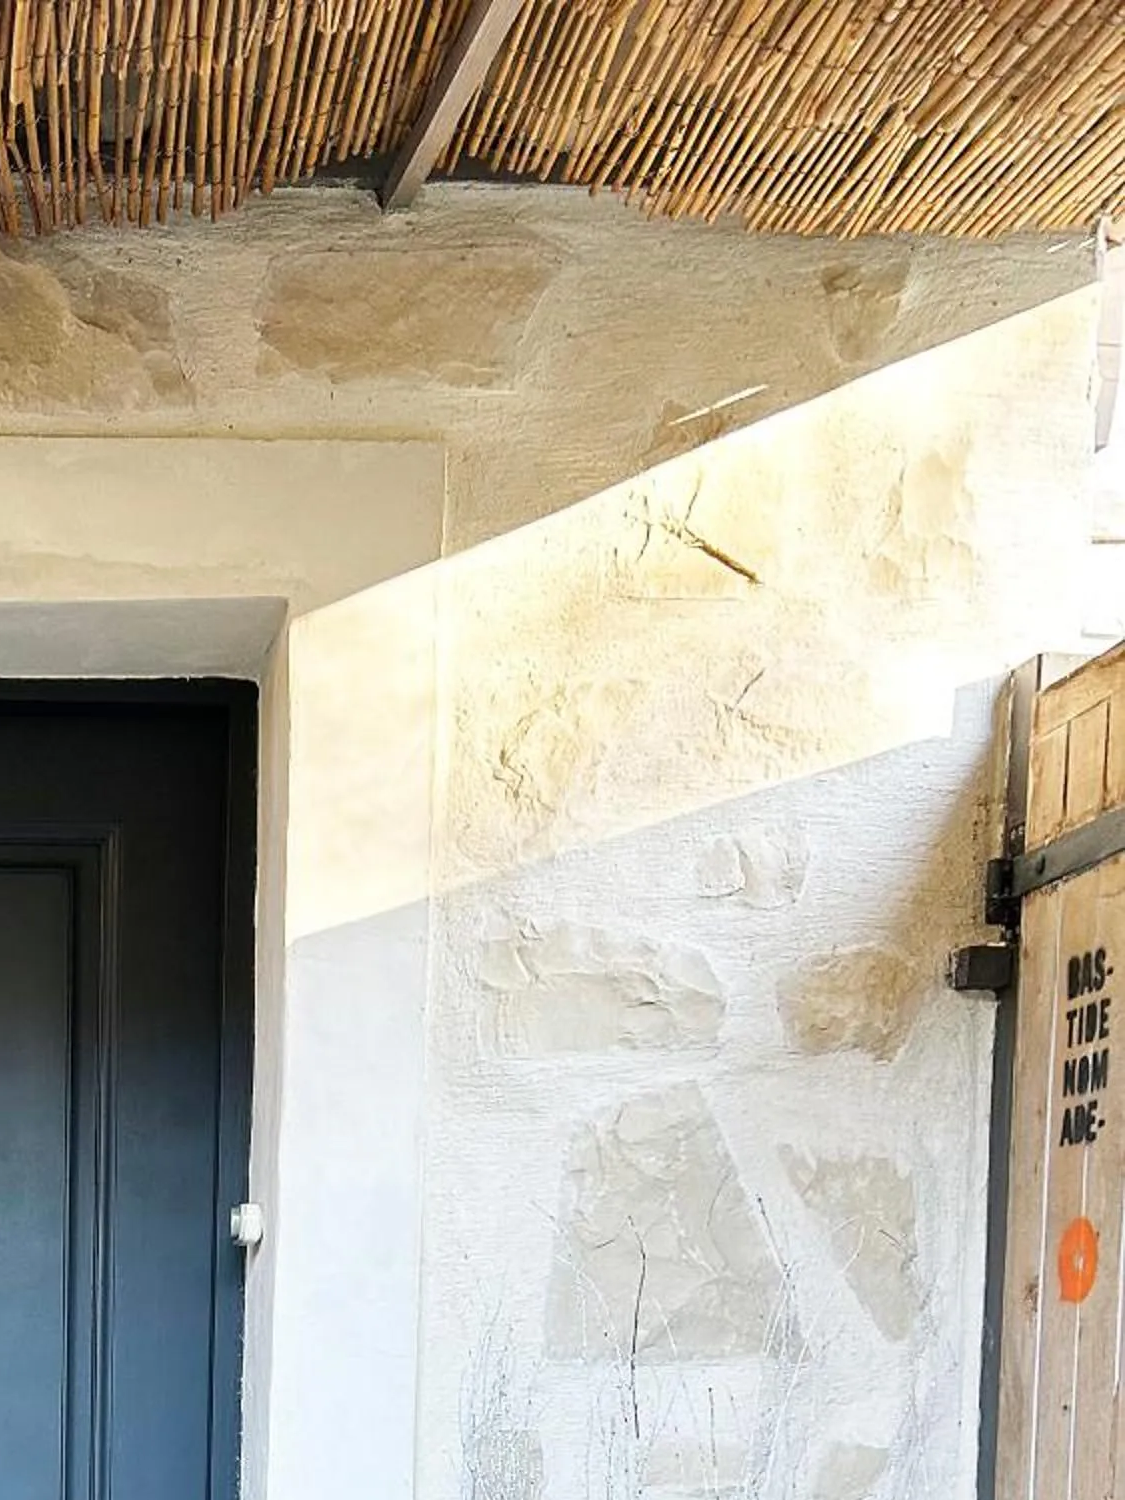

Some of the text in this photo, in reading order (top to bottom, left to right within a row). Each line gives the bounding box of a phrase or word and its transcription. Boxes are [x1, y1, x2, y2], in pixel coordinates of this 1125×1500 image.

[1067, 947, 1114, 1000] BAS-
[1066, 998, 1111, 1048] TIDE
[1063, 1048, 1109, 1097] NOM
[1059, 1100, 1105, 1147] ADE-
